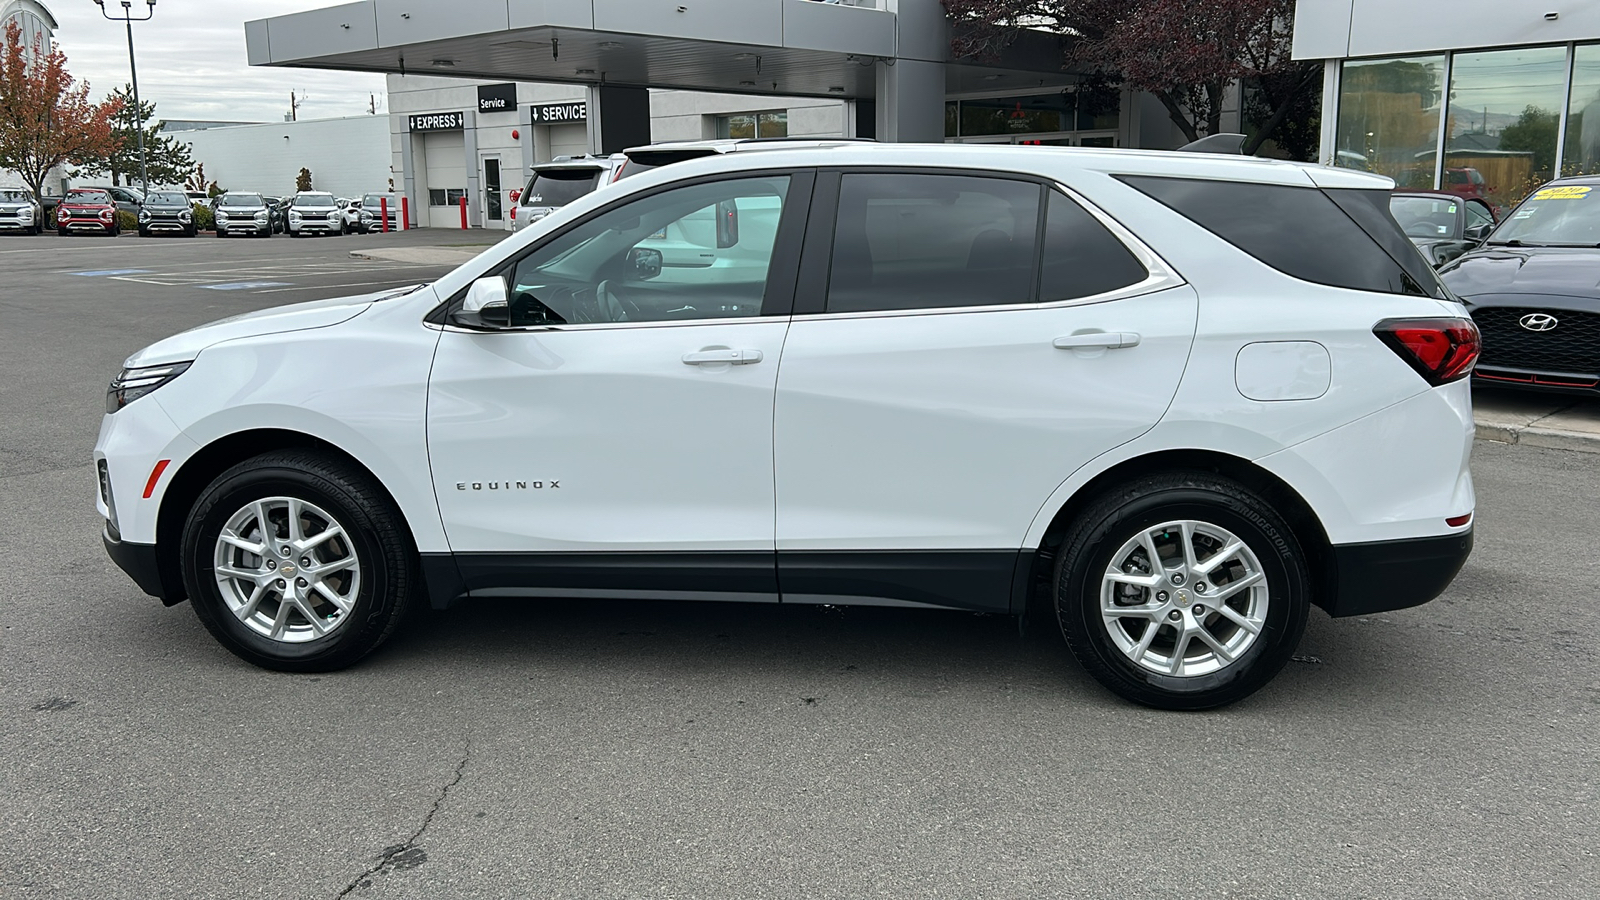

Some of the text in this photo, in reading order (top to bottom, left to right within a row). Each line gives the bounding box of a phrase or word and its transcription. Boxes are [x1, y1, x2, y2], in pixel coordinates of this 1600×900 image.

[480, 97, 505, 109] Service
[542, 104, 587, 121] SERVICE
[417, 115, 456, 130] EXPRESS
[456, 480, 560, 491] EQUINOX
[310, 477, 373, 530] BRIDGESTONE
[1230, 500, 1293, 560] BRIDGESTONE
